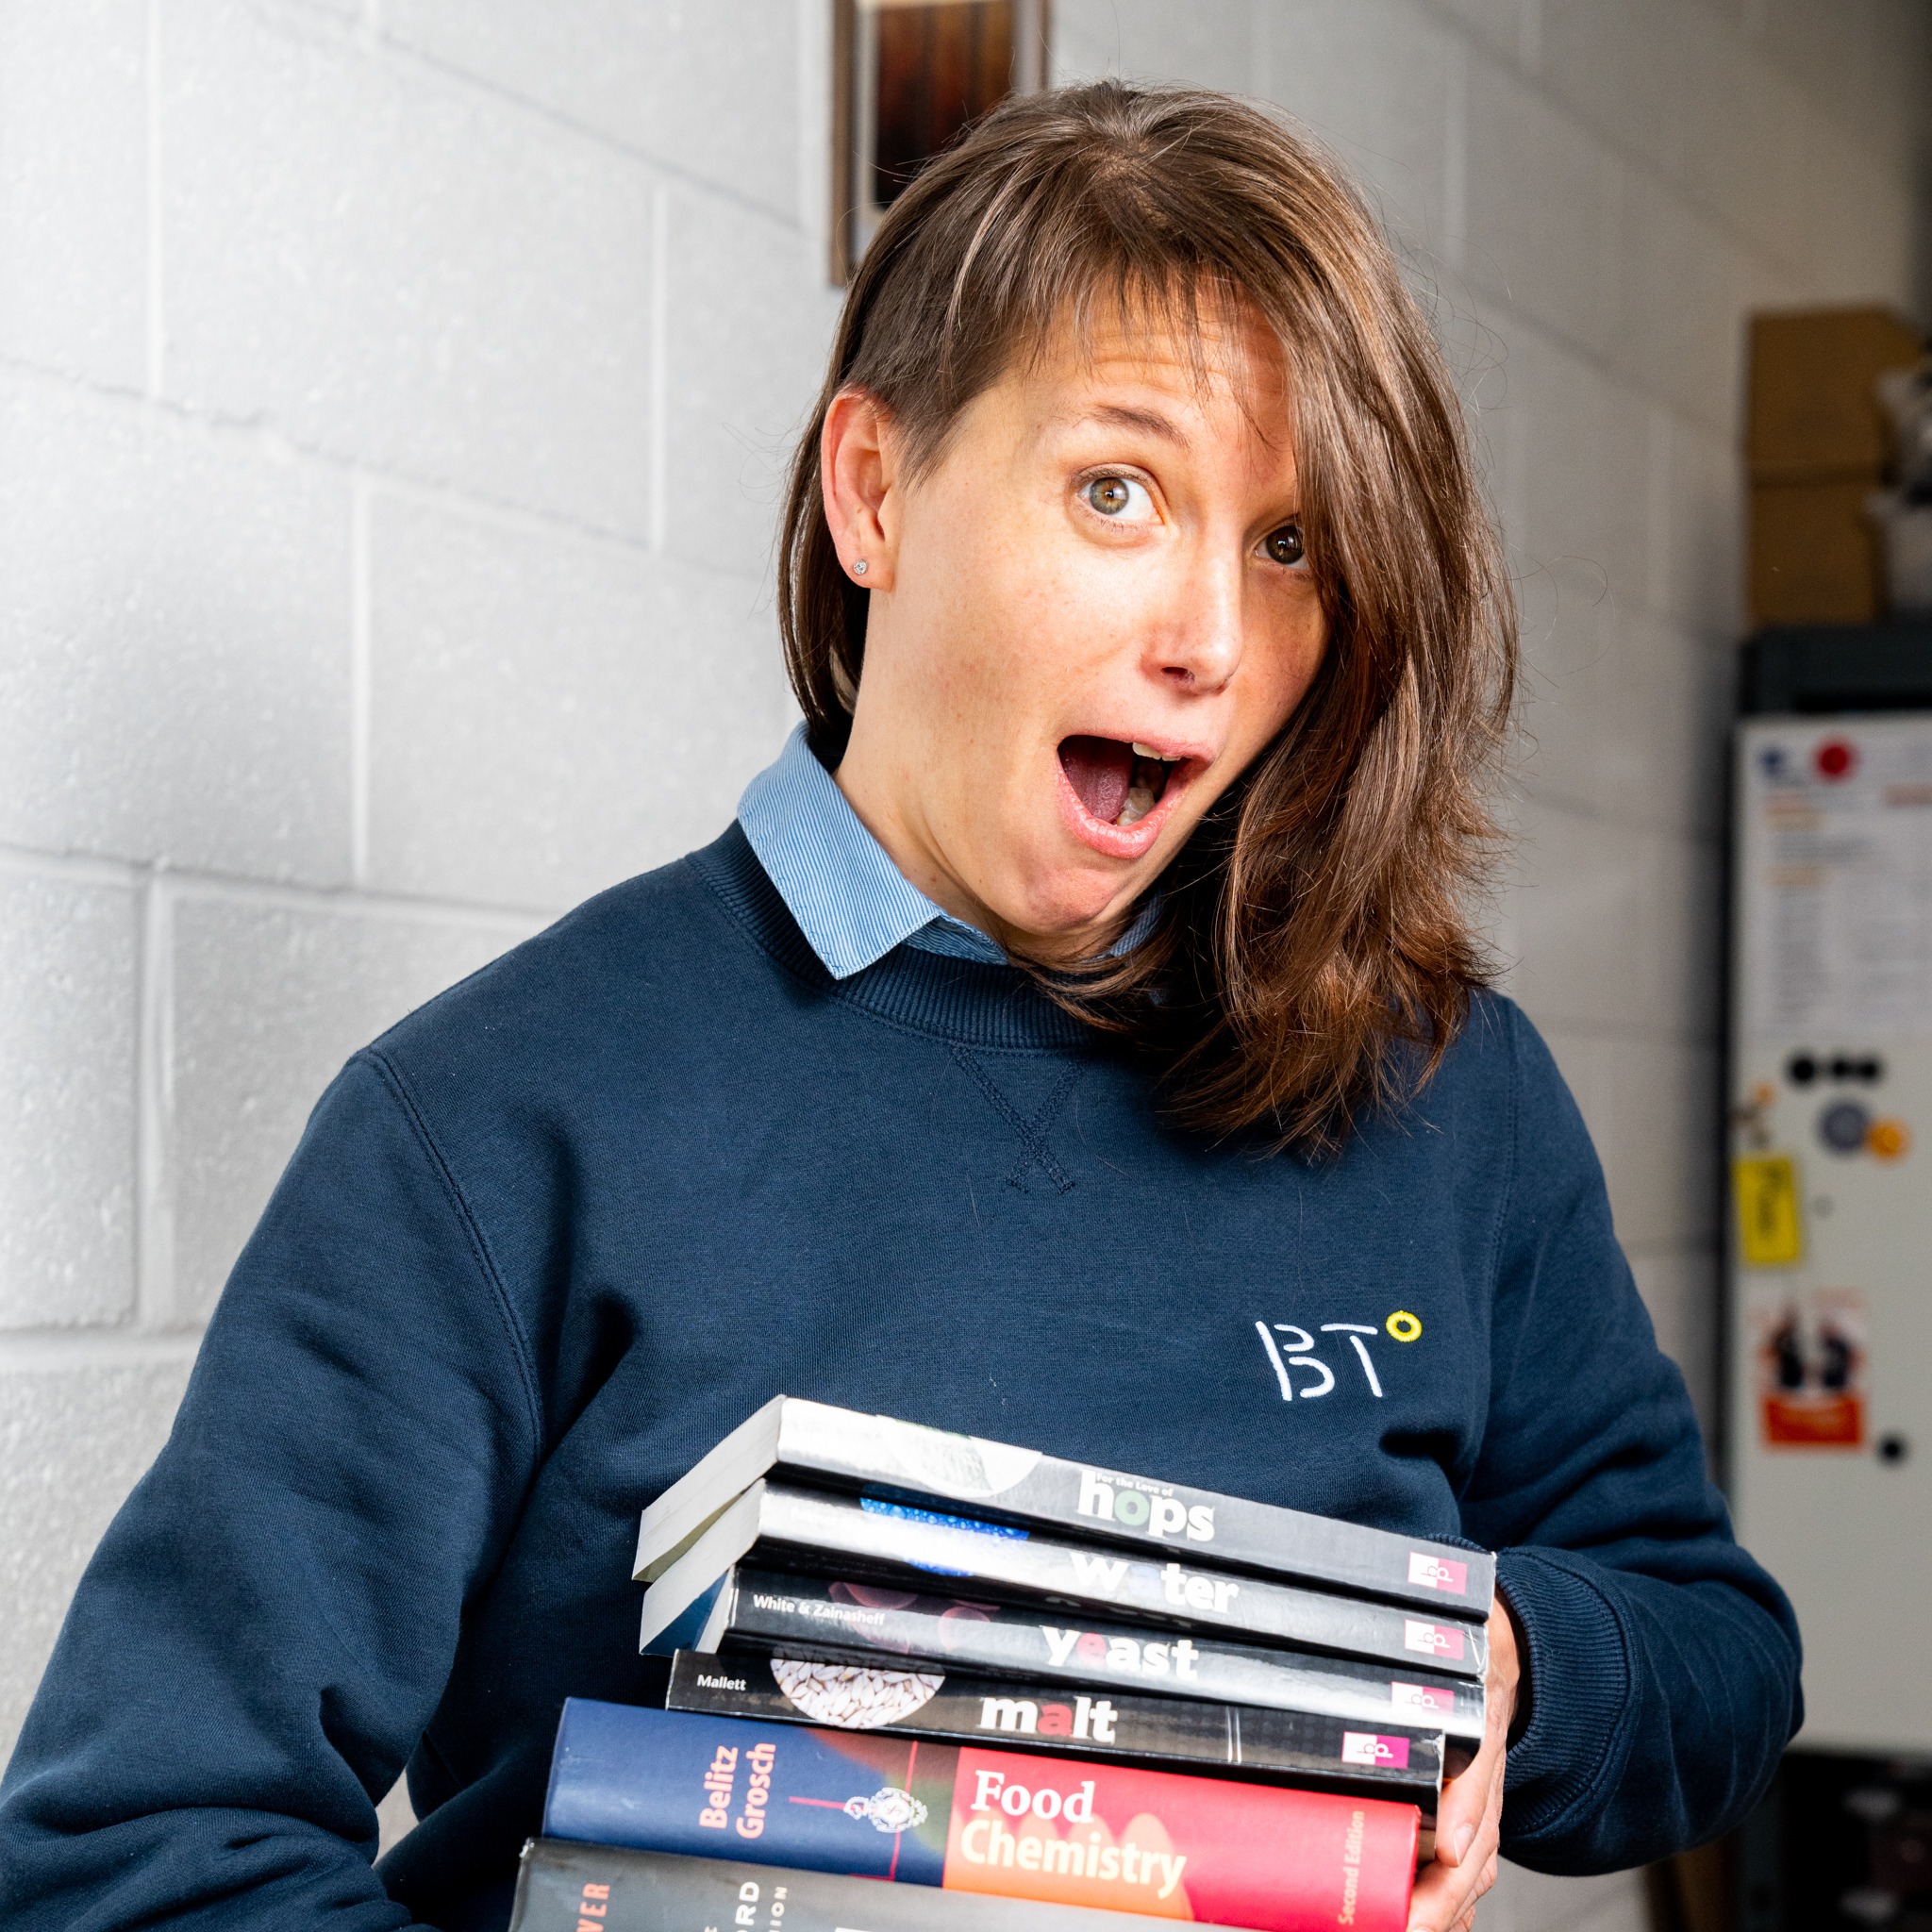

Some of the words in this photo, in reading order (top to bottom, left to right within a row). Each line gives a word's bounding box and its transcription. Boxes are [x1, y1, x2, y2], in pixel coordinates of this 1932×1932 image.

[1075, 1468, 1216, 1542] hops
[1095, 1472, 1114, 1484] For
[1115, 1476, 1134, 1489] the
[1135, 1480, 1160, 1494] Love
[1160, 1488, 1174, 1497] of
[753, 1594, 795, 1613] White
[798, 1601, 810, 1616] &
[812, 1604, 887, 1625] Zainasheff
[1039, 1624, 1200, 1682] yeast
[696, 1674, 747, 1691] Mallett
[976, 1695, 1119, 1745] malt
[699, 1745, 739, 1830] Belitz
[735, 1742, 776, 1840] Grosch
[970, 1769, 1096, 1824] Food
[960, 1819, 1188, 1900] Chemistry
[1343, 1810, 1365, 1865] Edition
[735, 1881, 760, 1932] RD
[768, 1886, 788, 1932] ION
[1338, 1866, 1359, 1926] Second
